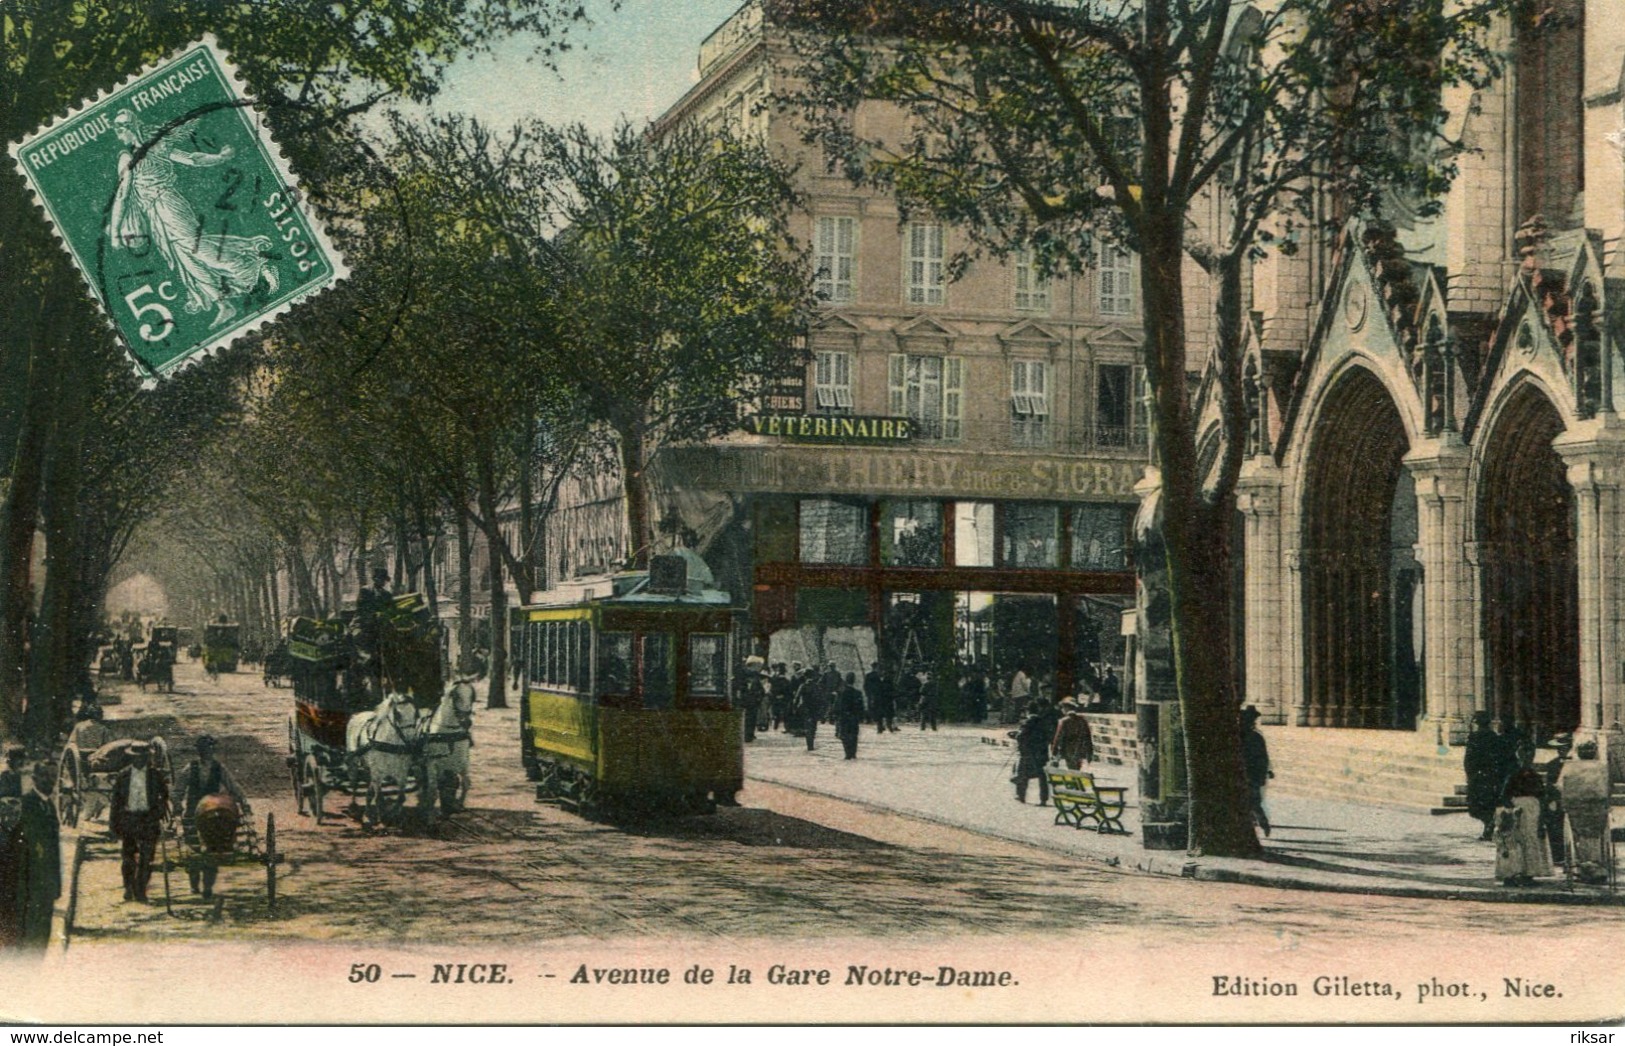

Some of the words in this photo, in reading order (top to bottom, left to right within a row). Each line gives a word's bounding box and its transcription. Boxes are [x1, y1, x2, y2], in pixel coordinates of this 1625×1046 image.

[29, 112, 112, 171] REPUBLIQUE
[131, 58, 210, 113] FRANÇAISE
[263, 192, 317, 272] POSTES
